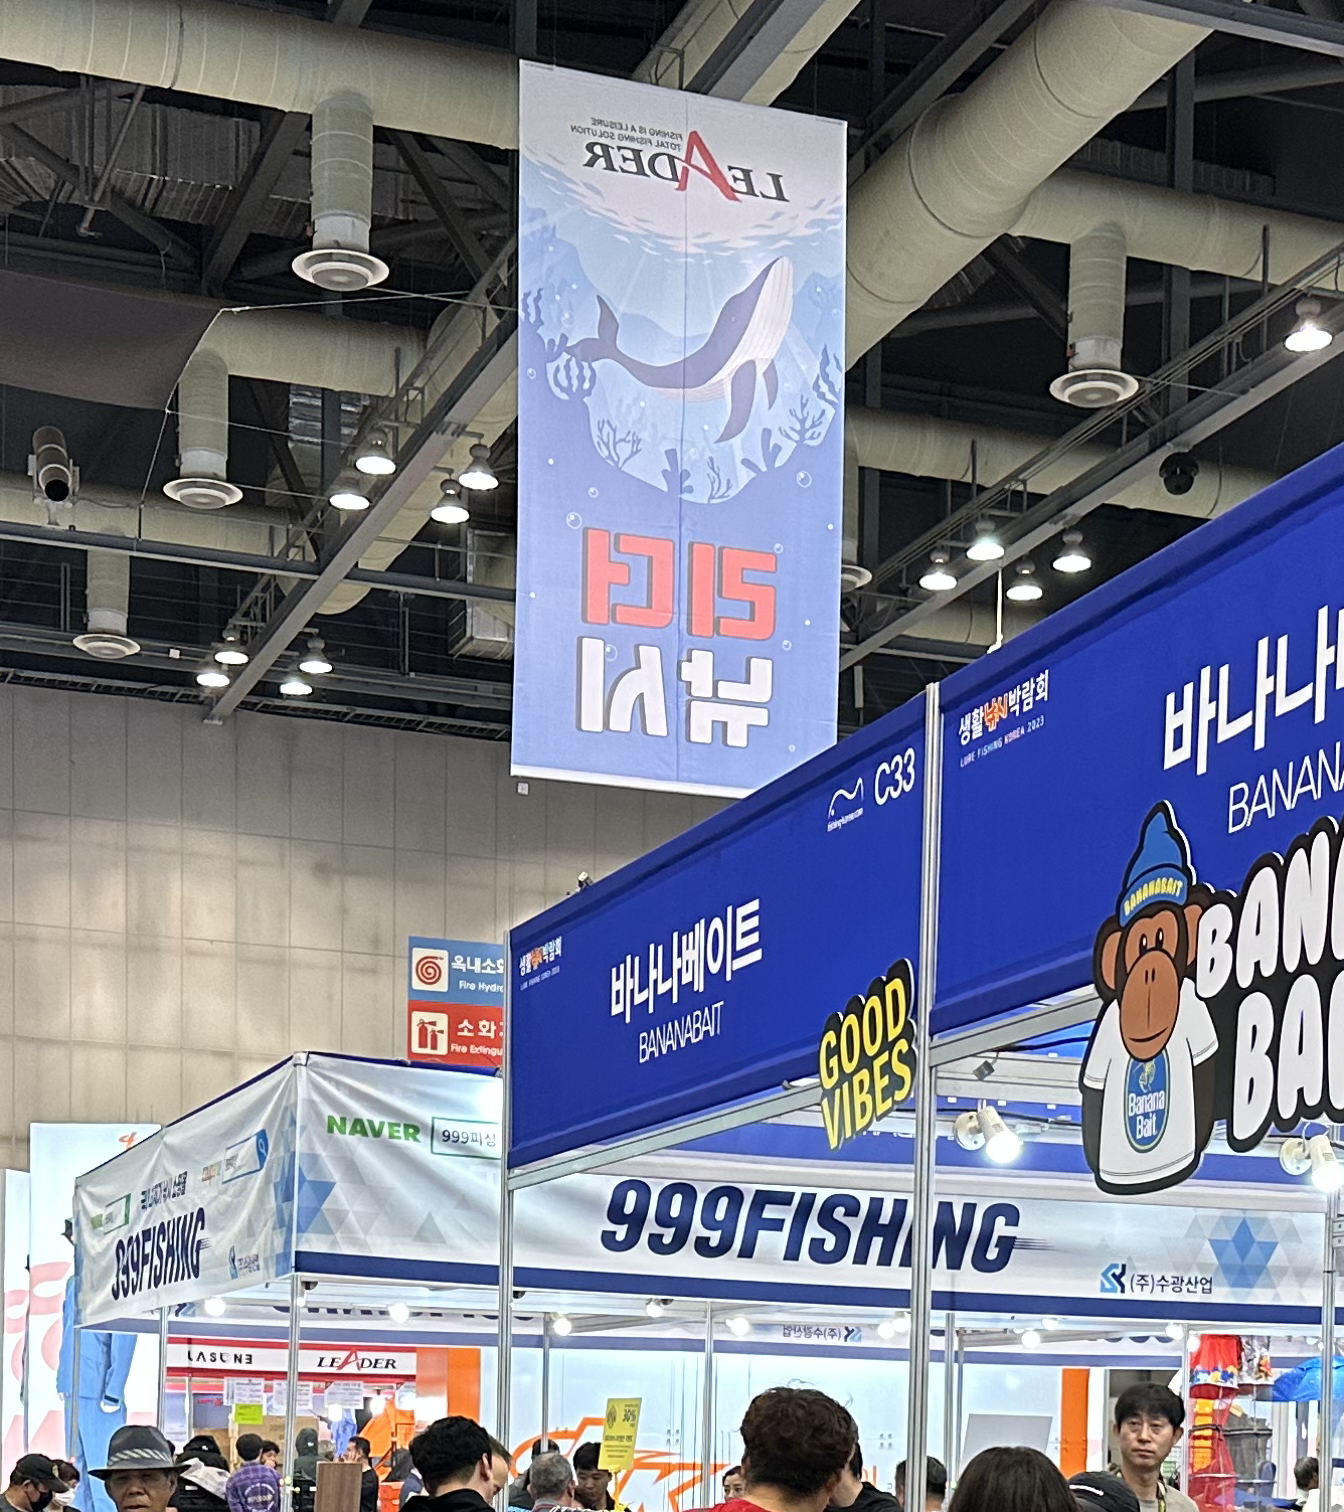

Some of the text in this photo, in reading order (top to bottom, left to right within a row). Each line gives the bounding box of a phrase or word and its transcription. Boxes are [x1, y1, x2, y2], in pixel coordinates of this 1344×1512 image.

[874, 747, 916, 806] C33
[1122, 876, 1185, 917] BANANABAIT
[610, 898, 763, 1025] 바나나베이트
[457, 1019, 503, 1039] 소화
[639, 1001, 724, 1063] BANANABAIT
[820, 976, 906, 1089] GOOD
[821, 1039, 912, 1151] VIBES
[1127, 1089, 1166, 1118] Banana
[326, 1114, 498, 1148] NAVER 999피싱
[1135, 1115, 1158, 1140] Bait
[1129, 1273, 1214, 1295] (주)수광산업
[317, 1348, 397, 1371] LEADER
